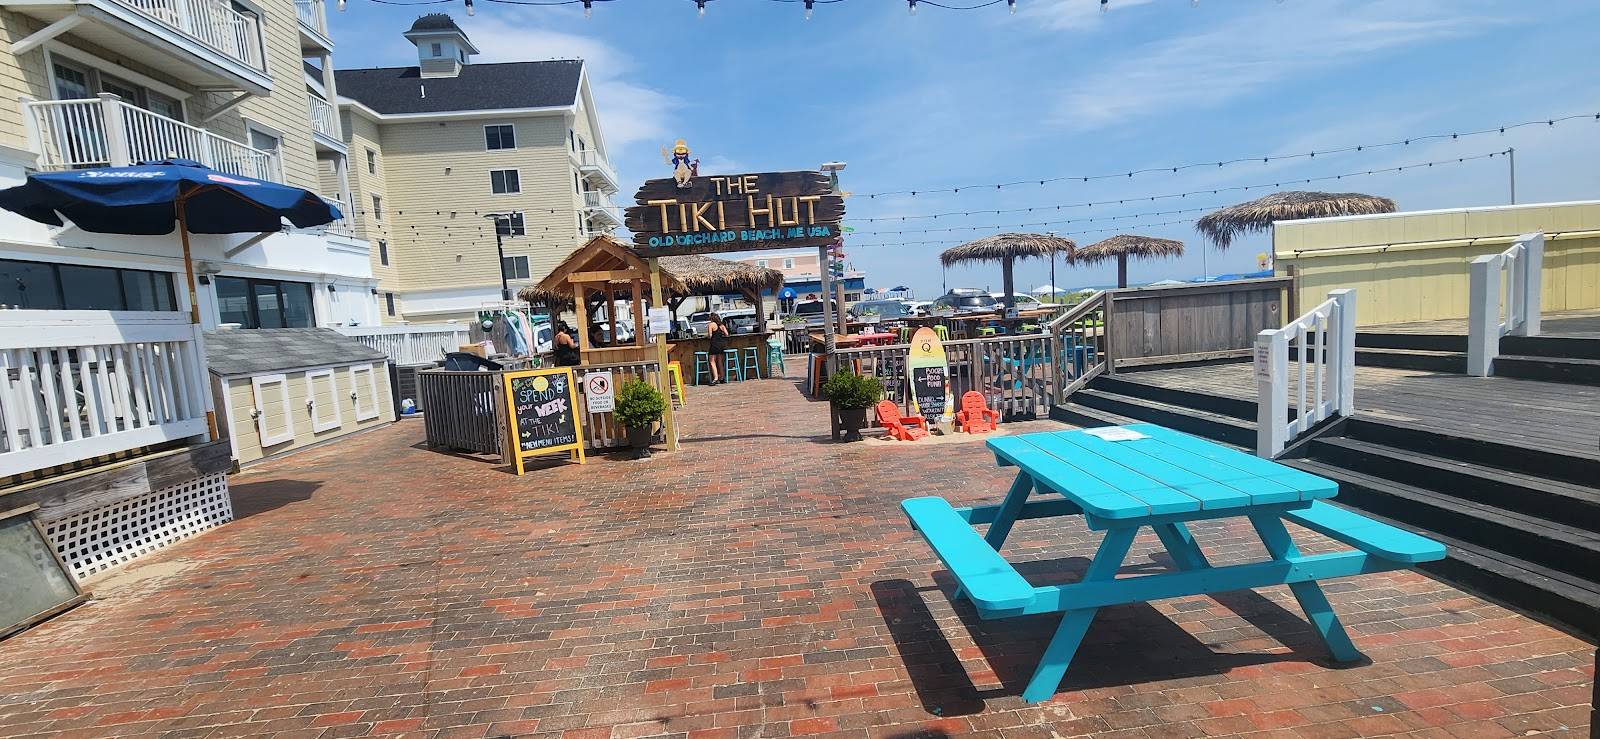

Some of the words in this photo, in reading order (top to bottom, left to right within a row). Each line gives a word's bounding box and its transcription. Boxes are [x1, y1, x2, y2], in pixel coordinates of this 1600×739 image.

[710, 175, 760, 196] THE
[647, 199, 726, 234] TIKI
[748, 193, 821, 229] HUT
[648, 235, 674, 248] OLD
[676, 231, 736, 246] ORCHARD
[786, 227, 804, 238] ME
[807, 226, 831, 237] USA
[520, 389, 555, 402] SPEND
[517, 403, 533, 414] your
[535, 398, 568, 417] WEEK
[532, 422, 560, 437] TIKI
[538, 438, 552, 447] MENU
